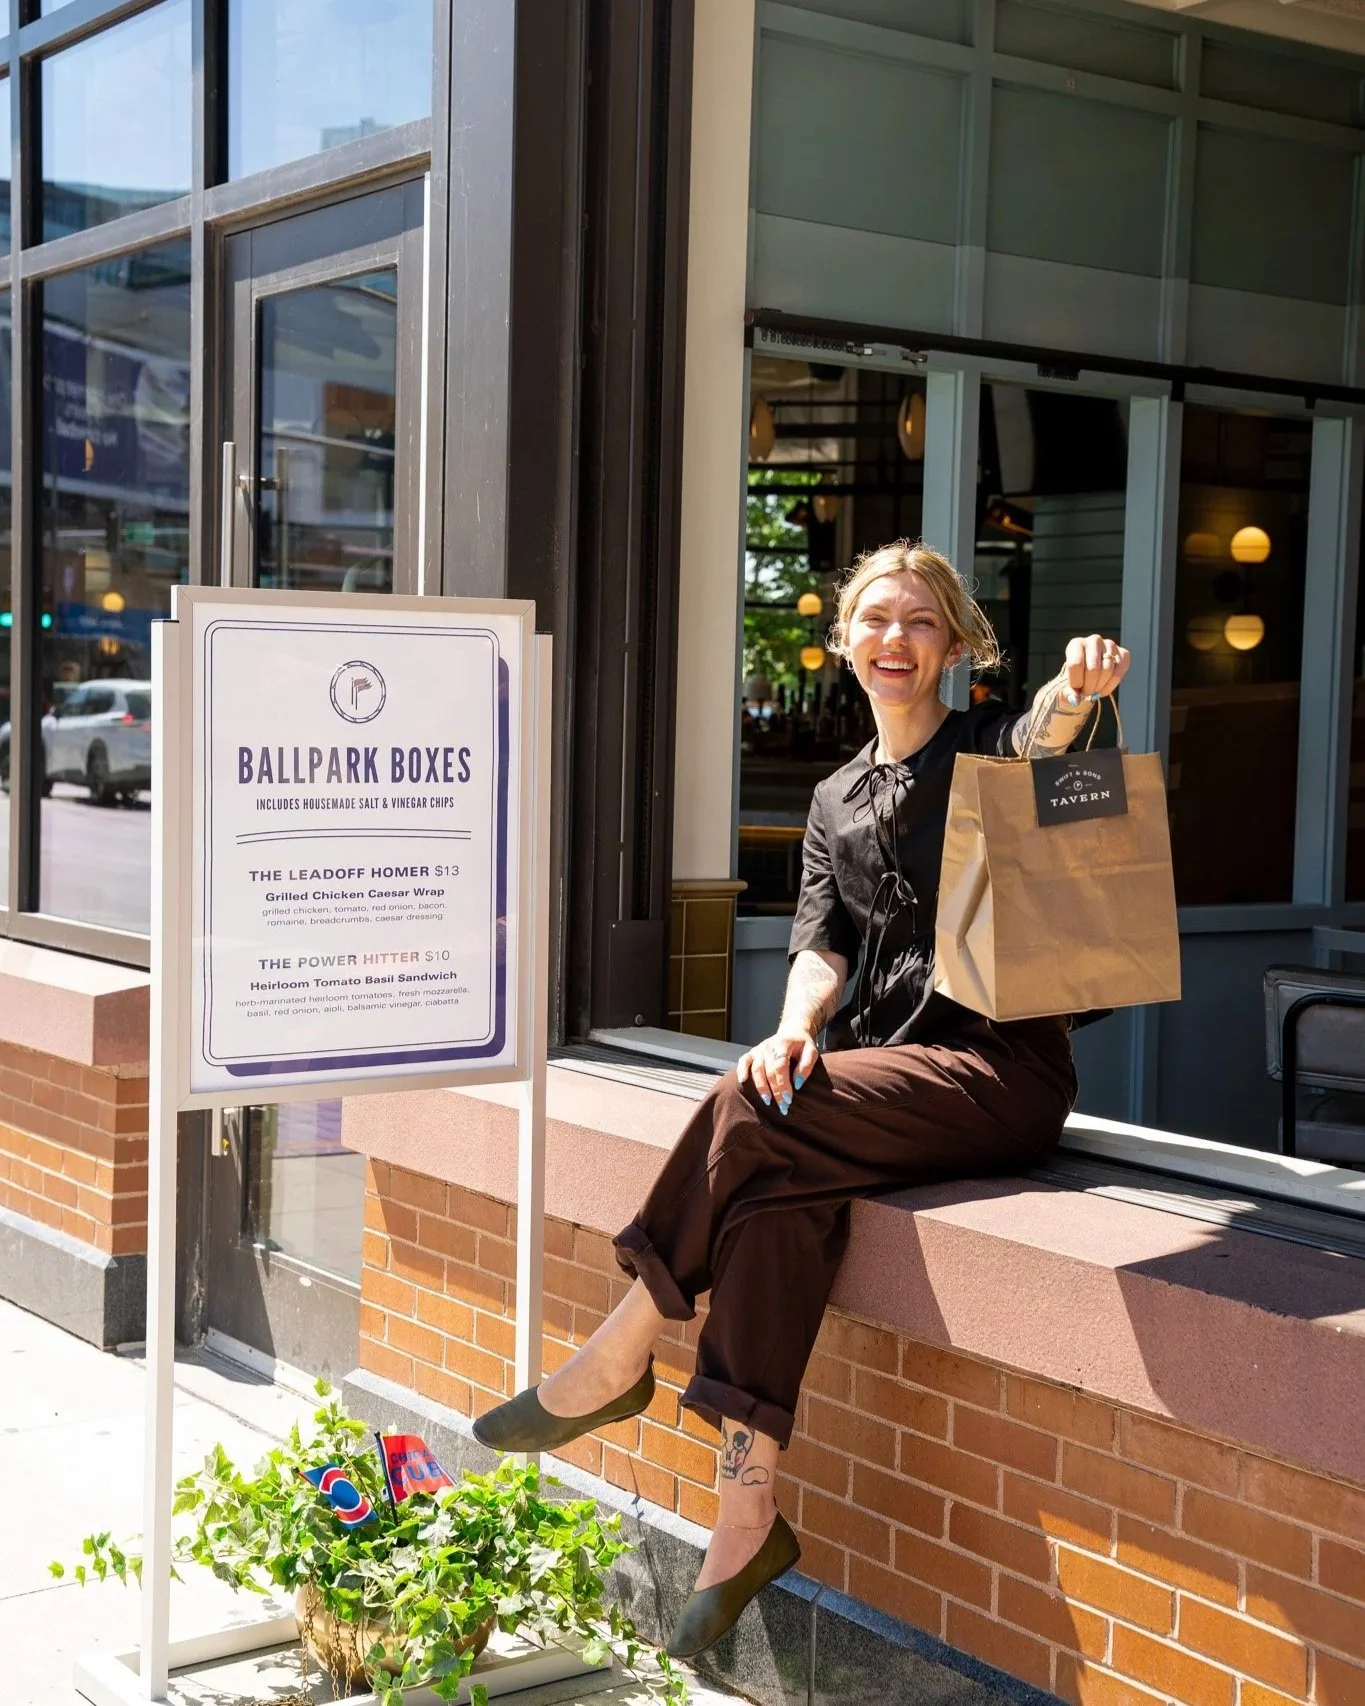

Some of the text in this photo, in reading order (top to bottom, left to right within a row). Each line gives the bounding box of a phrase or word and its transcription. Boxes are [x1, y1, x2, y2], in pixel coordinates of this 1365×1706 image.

[238, 746, 471, 784] BALLPARK BOXES
[256, 797, 454, 810] INCLUDES HOUSEMADE SALT & VINEGAR CHIPS
[1050, 790, 1110, 806] TAVERN
[249, 866, 460, 882] THE LEADOFF HOMER $13
[265, 888, 444, 902] Grilled Chicken Caesar Wrap
[262, 908, 290, 917] grilled
[293, 906, 331, 914] chicken,
[310, 916, 372, 924] breadcrumbs,
[258, 950, 450, 970] THE POWER HITTER $10
[250, 972, 457, 990] Heirloom Tomato Basil Sandwich
[235, 996, 306, 1008] herb-marinated
[309, 994, 349, 1002] heirloom
[351, 992, 396, 1000] tomatoes,
[398, 990, 421, 998] fresh
[247, 1008, 271, 1018] basil,
[324, 1004, 344, 1012] aioli,
[347, 1002, 387, 1012] balsamic
[425, 998, 459, 1006] ciabatta
[391, 1461, 443, 1486] CUB
